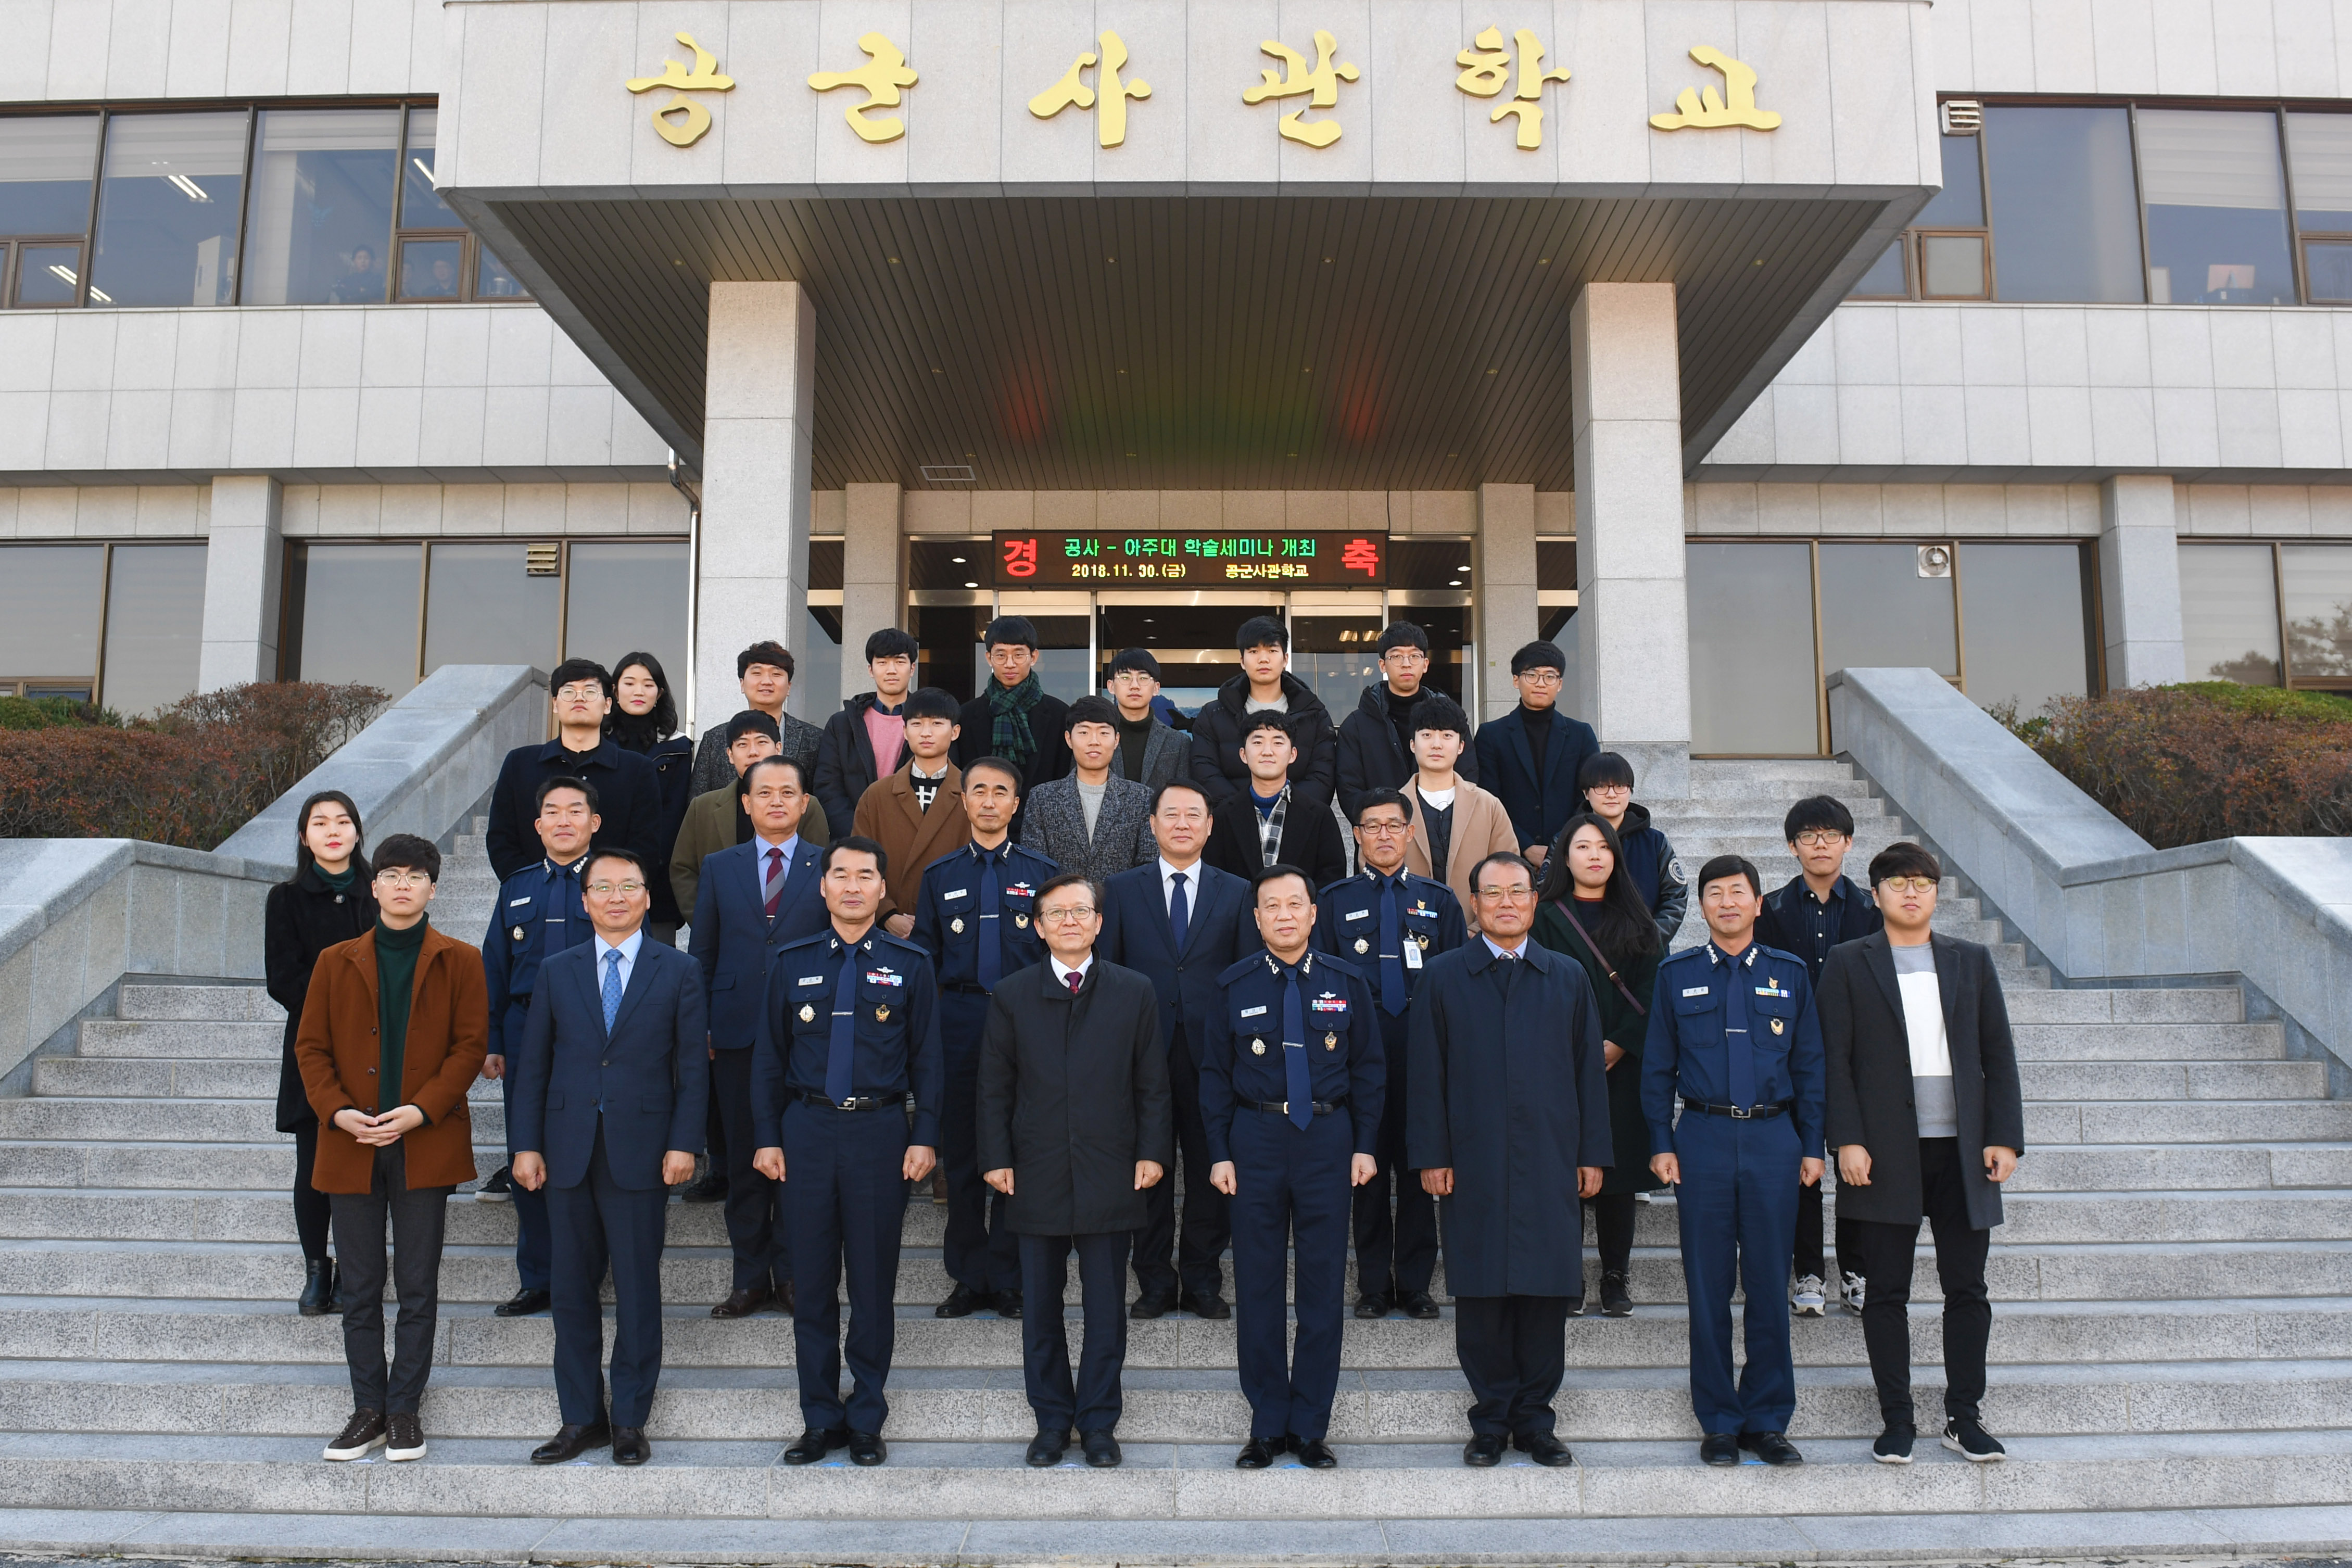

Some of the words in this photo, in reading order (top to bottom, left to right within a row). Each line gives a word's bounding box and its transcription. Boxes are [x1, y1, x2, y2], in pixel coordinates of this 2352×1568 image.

[625, 27, 1782, 152] 공군사관학교
[1003, 538, 1037, 577] 경
[1064, 538, 1099, 557] 공사
[1124, 538, 1176, 557] 아주대
[1184, 538, 1274, 557] 학술세미나
[1281, 538, 1316, 557] 개최
[1341, 538, 1380, 578] 축
[1225, 562, 1310, 579] 공군사관학교
